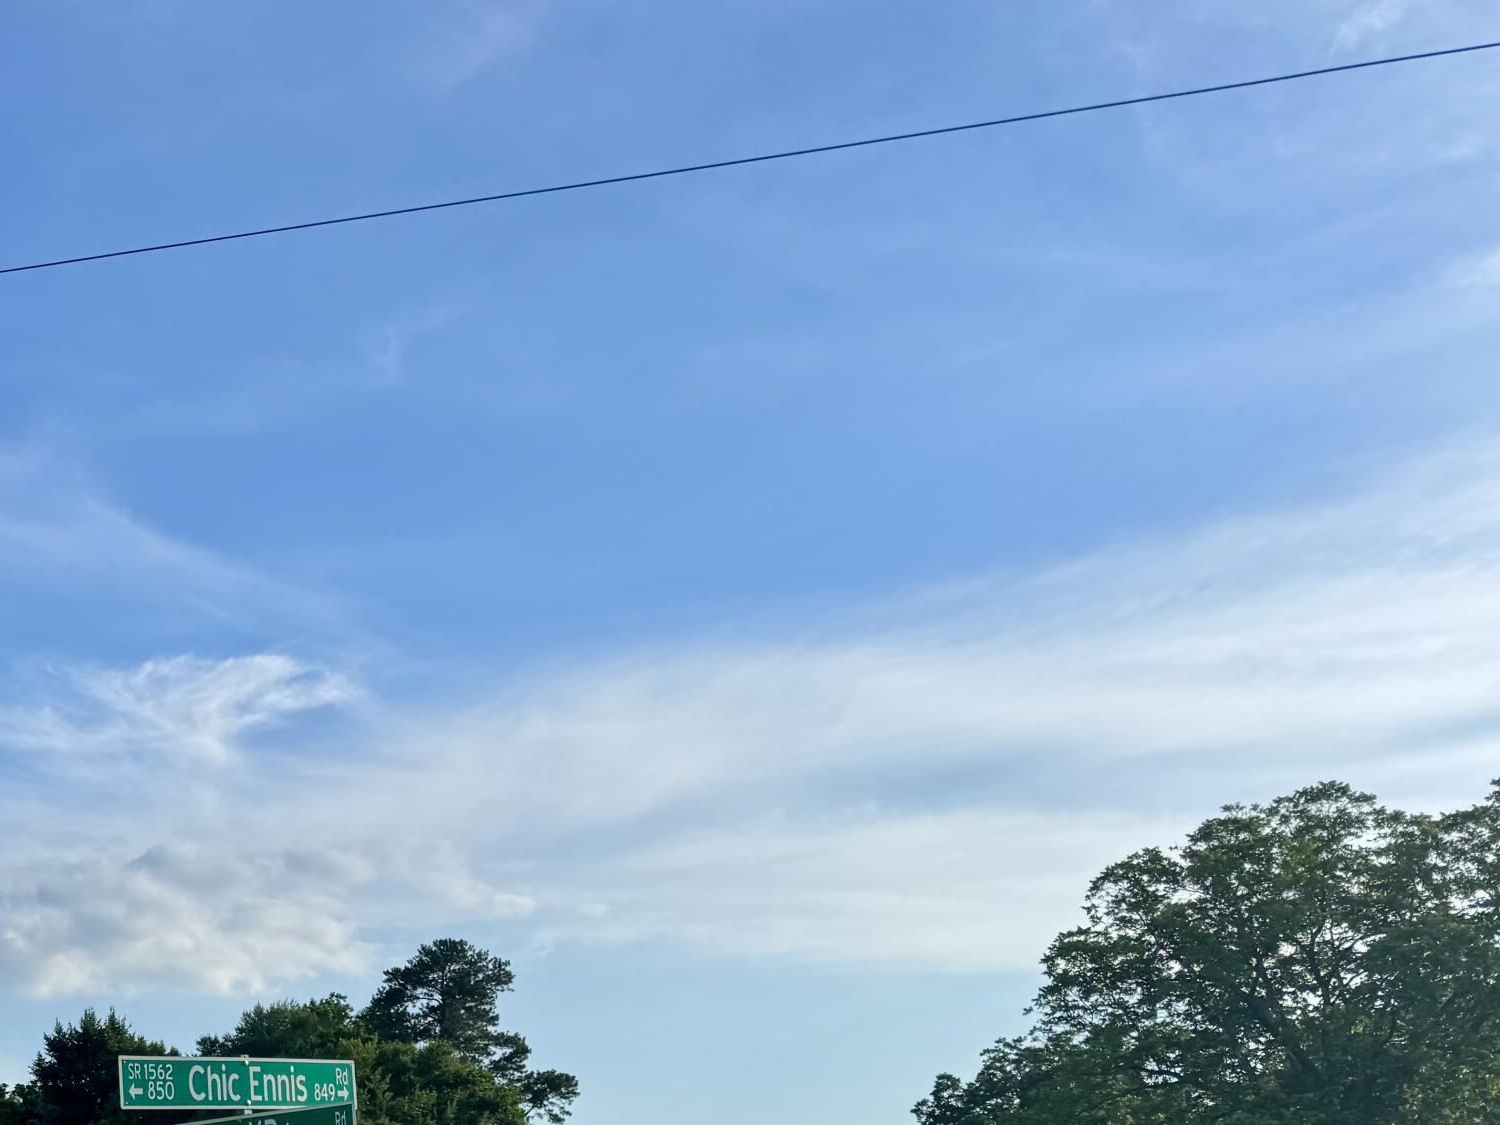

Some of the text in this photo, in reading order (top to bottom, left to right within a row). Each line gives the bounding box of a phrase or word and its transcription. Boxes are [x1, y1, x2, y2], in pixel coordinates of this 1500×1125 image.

[128, 1063, 174, 1080] SR 1562
[335, 1067, 349, 1086] Rd
[147, 1081, 175, 1100] 850
[188, 1063, 308, 1102] Chic Ennis
[314, 1083, 335, 1101] 849
